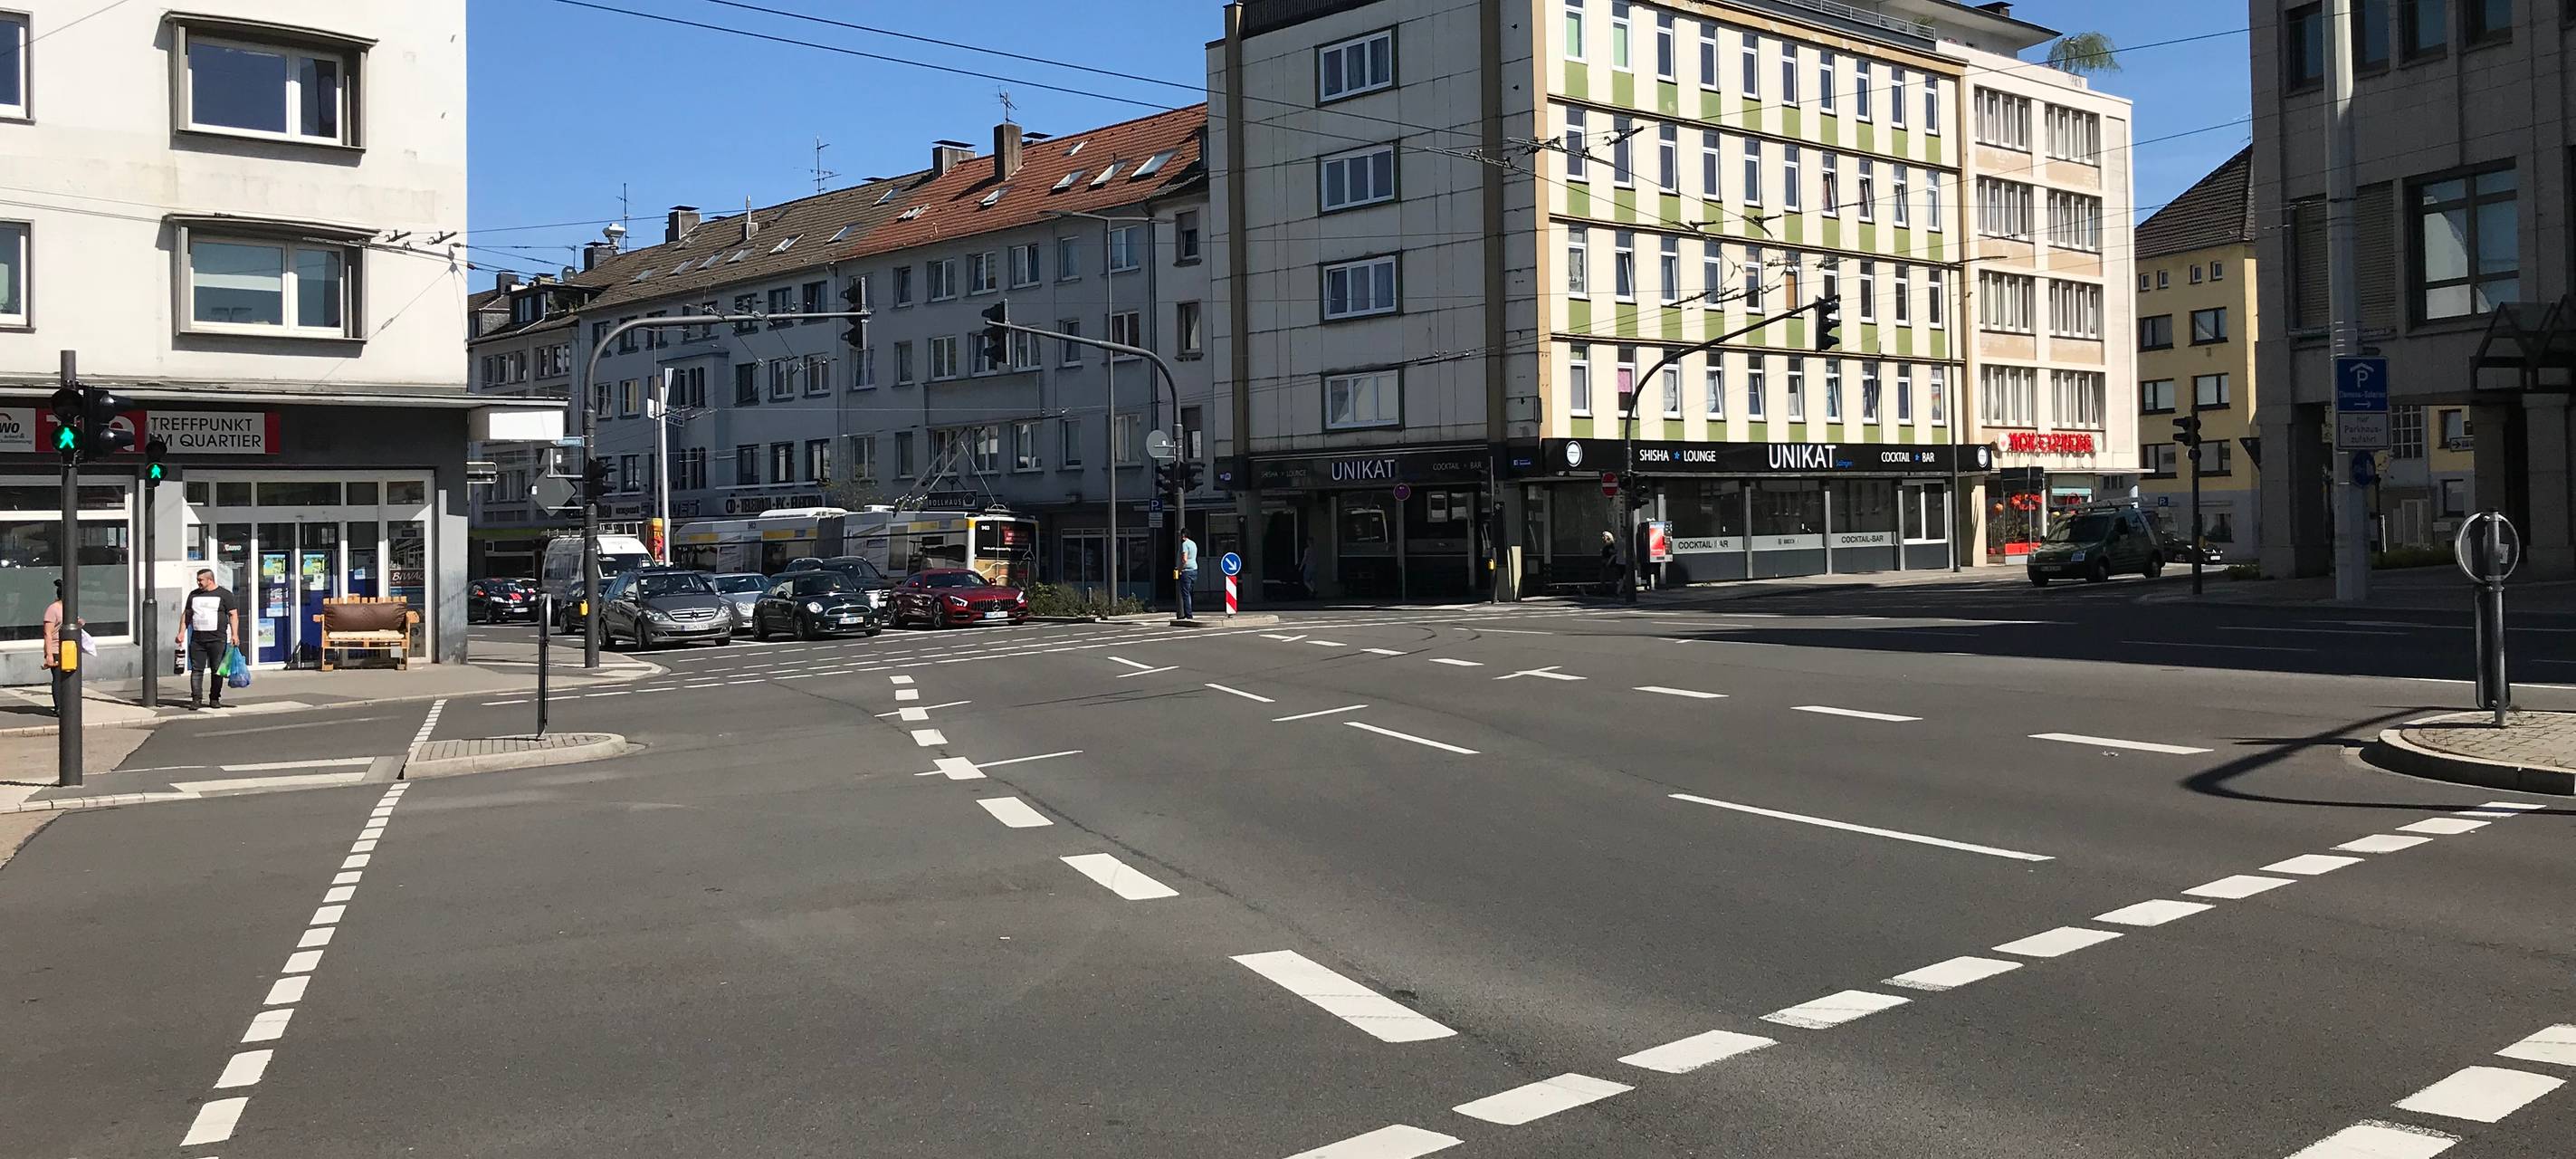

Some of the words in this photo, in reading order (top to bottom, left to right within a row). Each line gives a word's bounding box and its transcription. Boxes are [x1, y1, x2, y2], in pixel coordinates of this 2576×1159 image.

[150, 417, 253, 432] TREFFPUNKT
[179, 434, 262, 448] QUARTIER
[1639, 449, 1670, 462] SHISHA
[1684, 450, 1716, 462] LOUNGE
[1769, 444, 1837, 469] UNIKAT
[1881, 451, 1911, 463] COCKTAIL
[1922, 452, 1935, 463] BAR
[1331, 459, 1395, 481] UNIKAT
[1432, 461, 1460, 472] COCKTAIL
[1470, 460, 1483, 470] BAR
